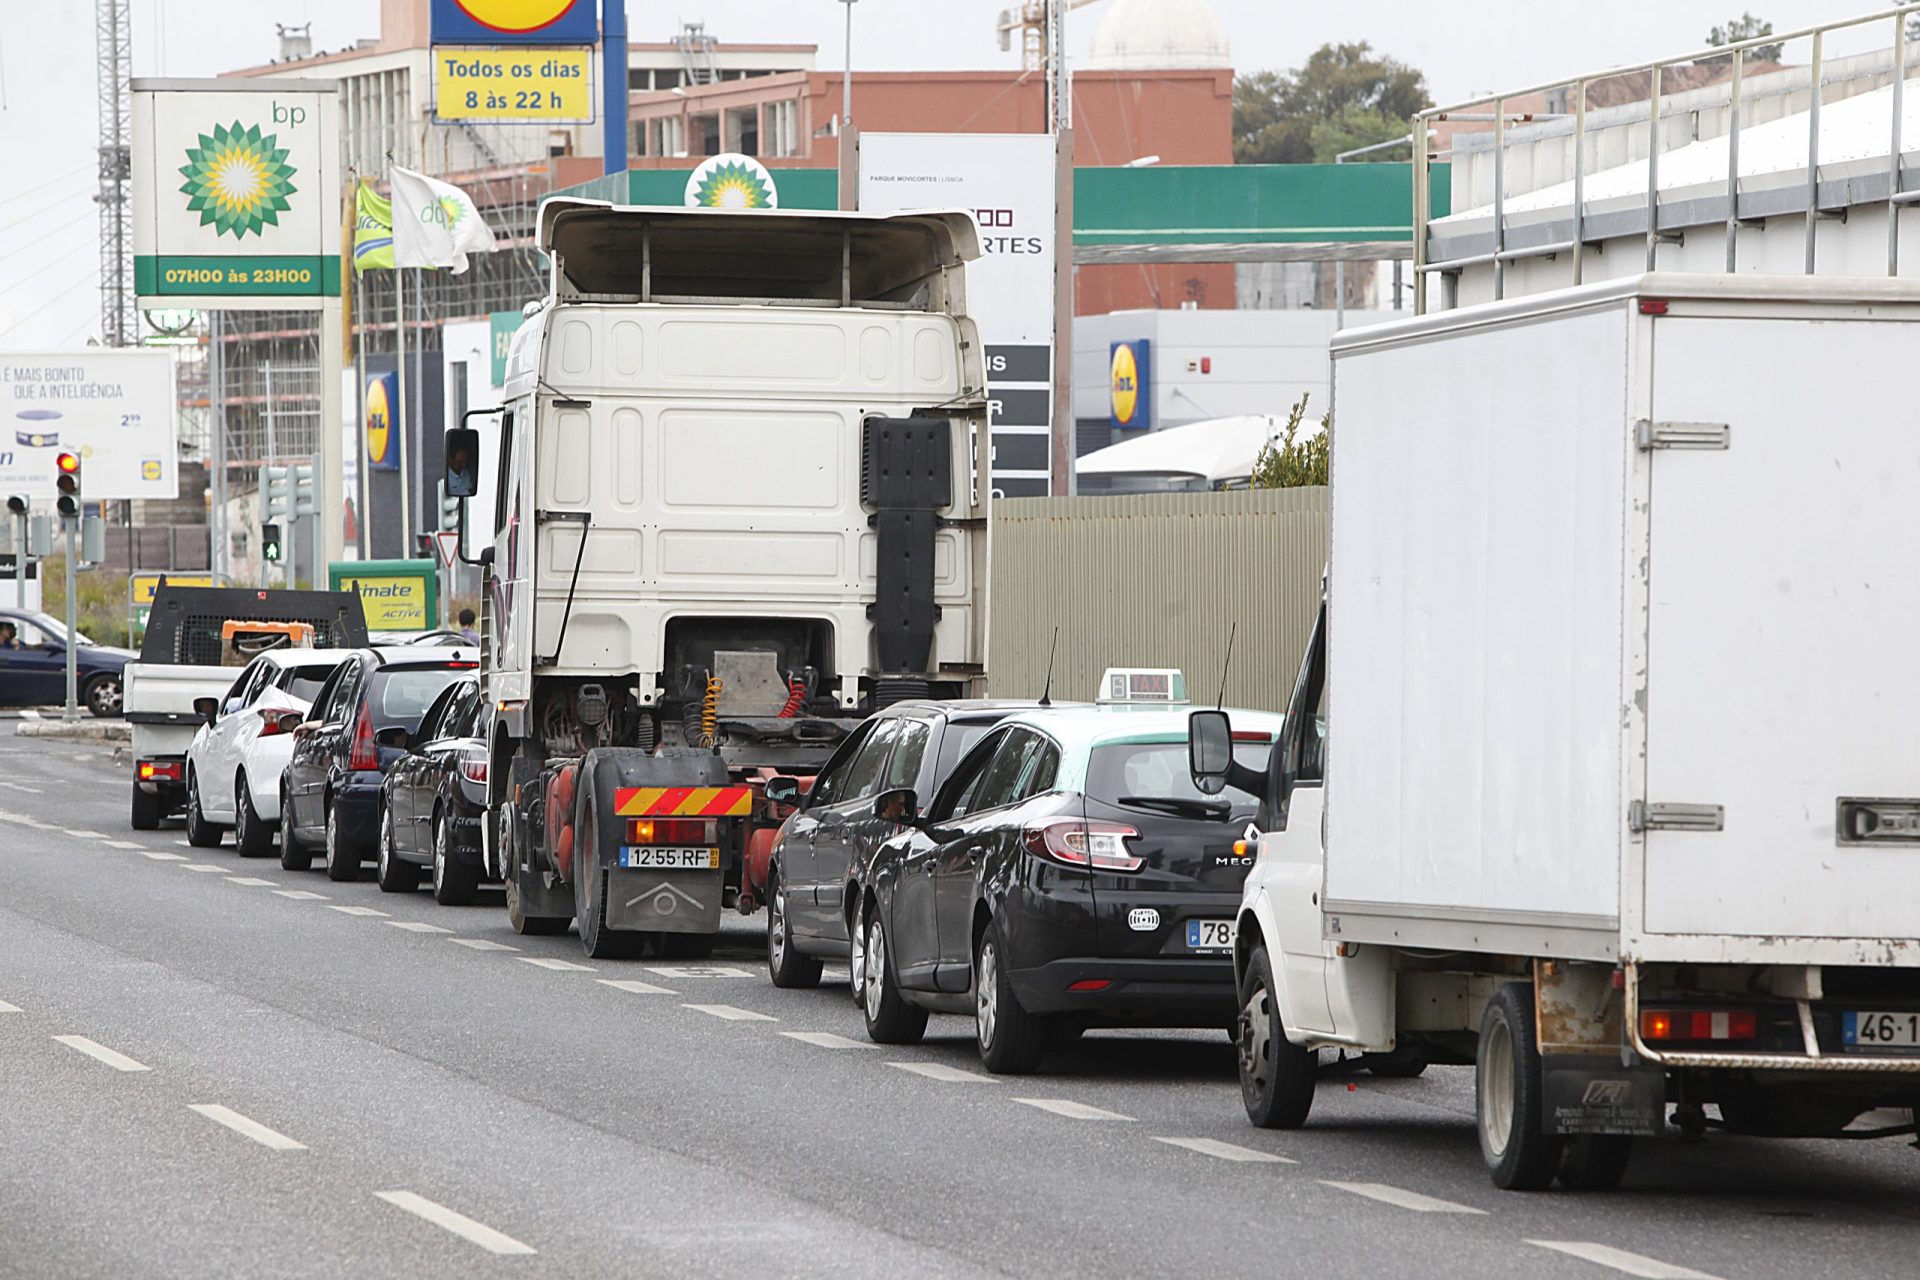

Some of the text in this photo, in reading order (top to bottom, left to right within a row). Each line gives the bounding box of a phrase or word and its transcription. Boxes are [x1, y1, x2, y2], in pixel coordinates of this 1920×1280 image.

[445, 59, 581, 78] Todos os dias
[465, 90, 562, 109] 8 às 22 h
[272, 100, 306, 129] bp
[869, 175, 896, 183] PARQUE
[165, 268, 312, 284] 07H00 às 23H00
[14, 368, 42, 382] MAIS
[45, 367, 85, 382] BONITO
[14, 382, 123, 399] QUE A INTELIGÊNCIA
[1132, 675, 1168, 692] TAXI
